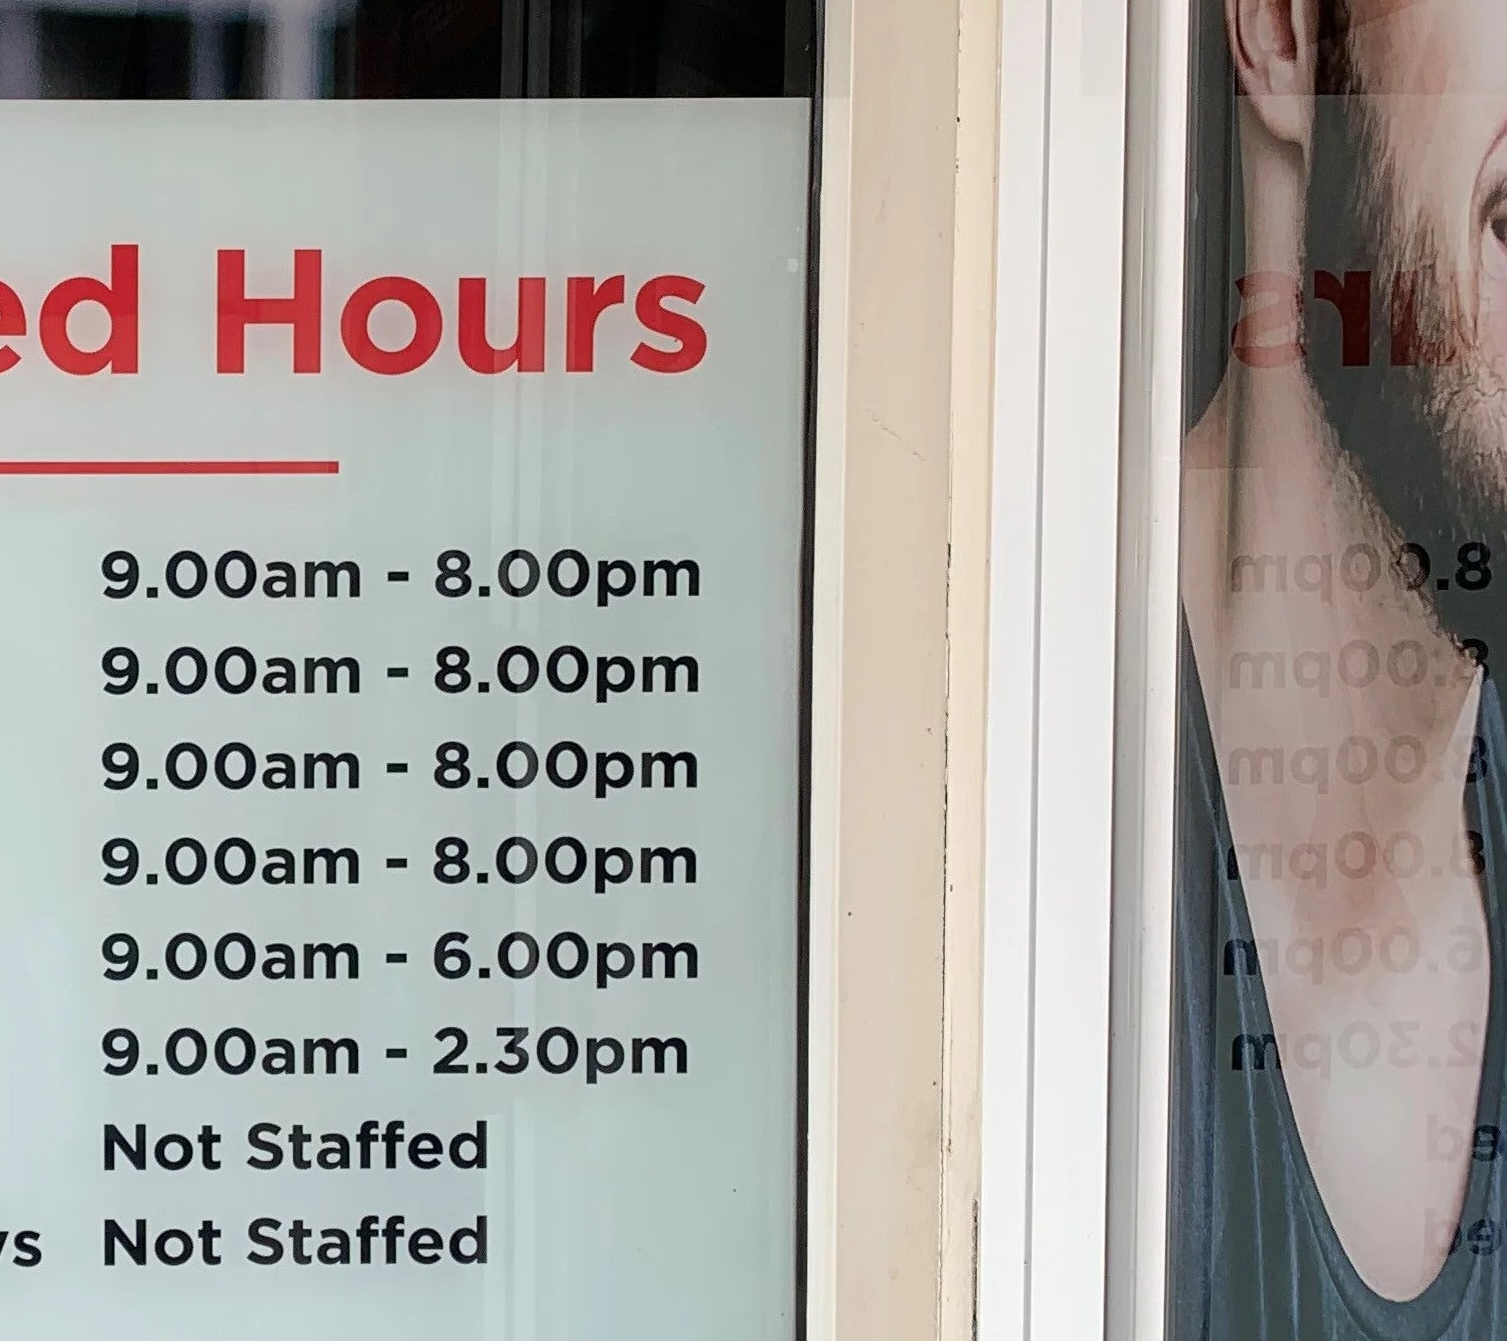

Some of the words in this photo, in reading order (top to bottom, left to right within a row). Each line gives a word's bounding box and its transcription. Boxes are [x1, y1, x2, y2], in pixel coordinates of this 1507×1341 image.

[217, 249, 707, 375] Hours
[101, 550, 360, 599] 9.00am
[387, 571, 409, 582] -
[435, 549, 700, 607] 8.00pm
[102, 646, 360, 695] 9.00am
[387, 667, 409, 678] -
[435, 645, 698, 703] 8.00pm
[102, 742, 359, 790] 9.00am
[386, 763, 408, 773] -
[434, 741, 697, 799] 8.00pm
[101, 837, 359, 886] 9.00am
[386, 858, 407, 868] -
[433, 836, 696, 894] 8.00pm
[102, 932, 359, 981] 9.00am
[386, 953, 407, 963] -
[434, 931, 698, 989] 6.00pm
[102, 1027, 359, 1076] 9.00am
[386, 1048, 407, 1058] -
[433, 1026, 687, 1084] 2.30pm
[104, 1124, 221, 1171] Not
[246, 1120, 487, 1170] Staffed
[104, 1219, 221, 1266] Not
[247, 1215, 487, 1265] Staffed
